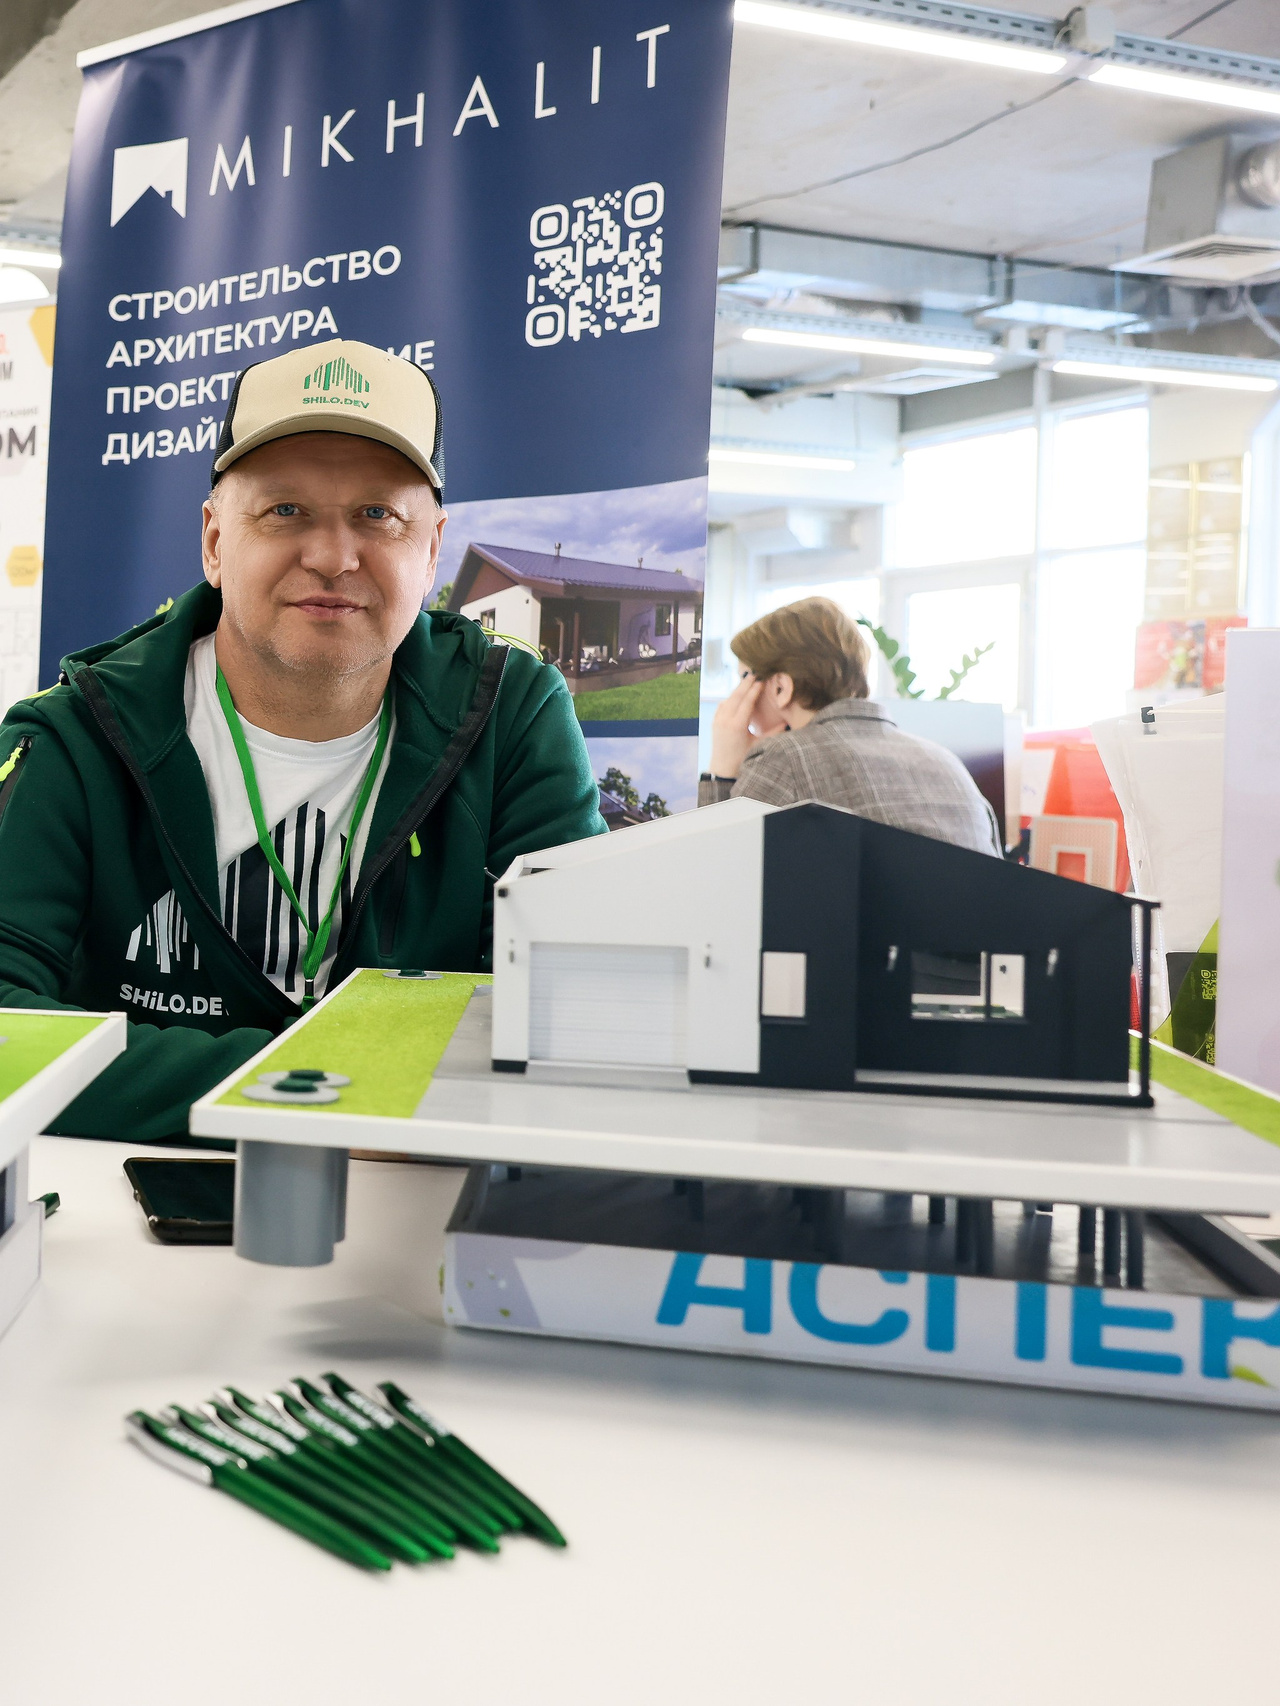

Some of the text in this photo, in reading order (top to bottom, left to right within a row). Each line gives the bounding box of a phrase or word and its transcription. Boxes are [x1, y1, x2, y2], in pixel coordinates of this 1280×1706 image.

[208, 24, 671, 196] MIKHALIT
[108, 244, 403, 323] СТРОИТЕЛЬСТВО
[105, 305, 339, 369] АРХИТЕКТУРА
[119, 983, 230, 1017] SHiLO.DE
